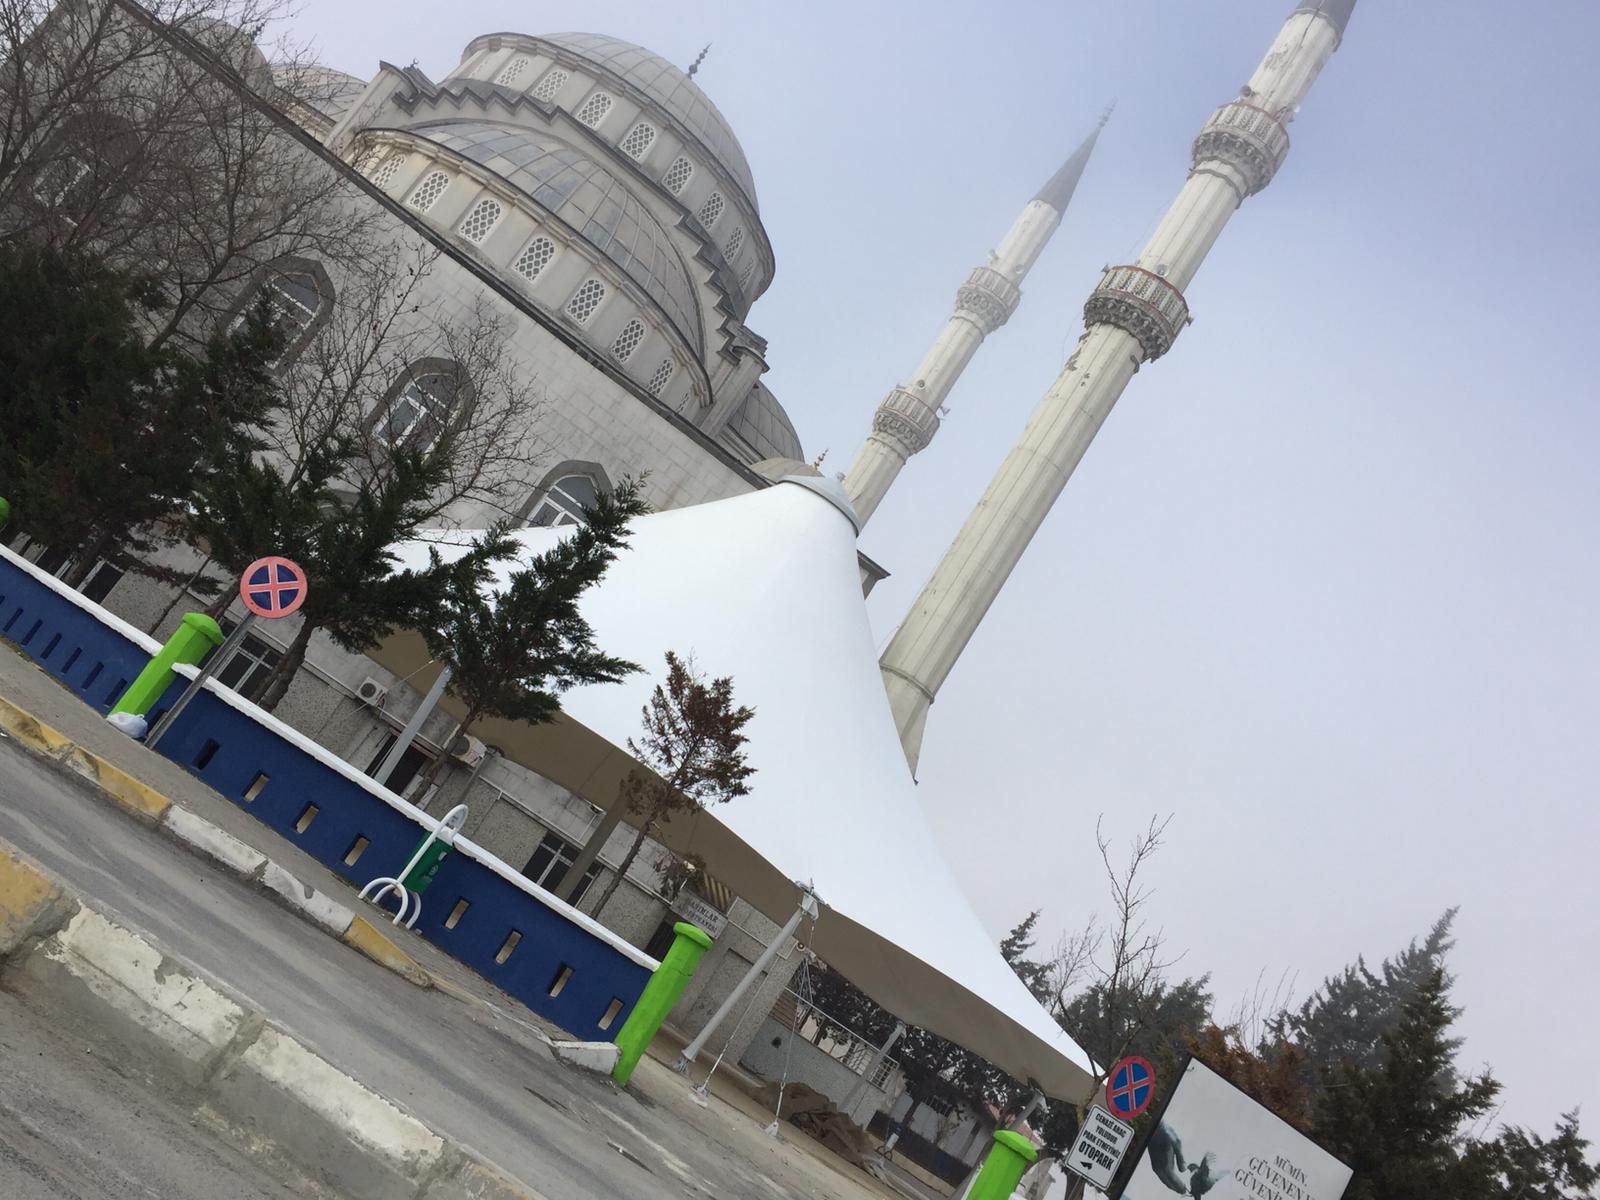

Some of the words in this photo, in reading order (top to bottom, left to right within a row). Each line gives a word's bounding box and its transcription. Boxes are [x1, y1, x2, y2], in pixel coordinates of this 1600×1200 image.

[1083, 1130, 1097, 1144] PARK
[1078, 1141, 1114, 1170] OTOPARK
[1249, 1157, 1304, 1200] GÜVENEN
